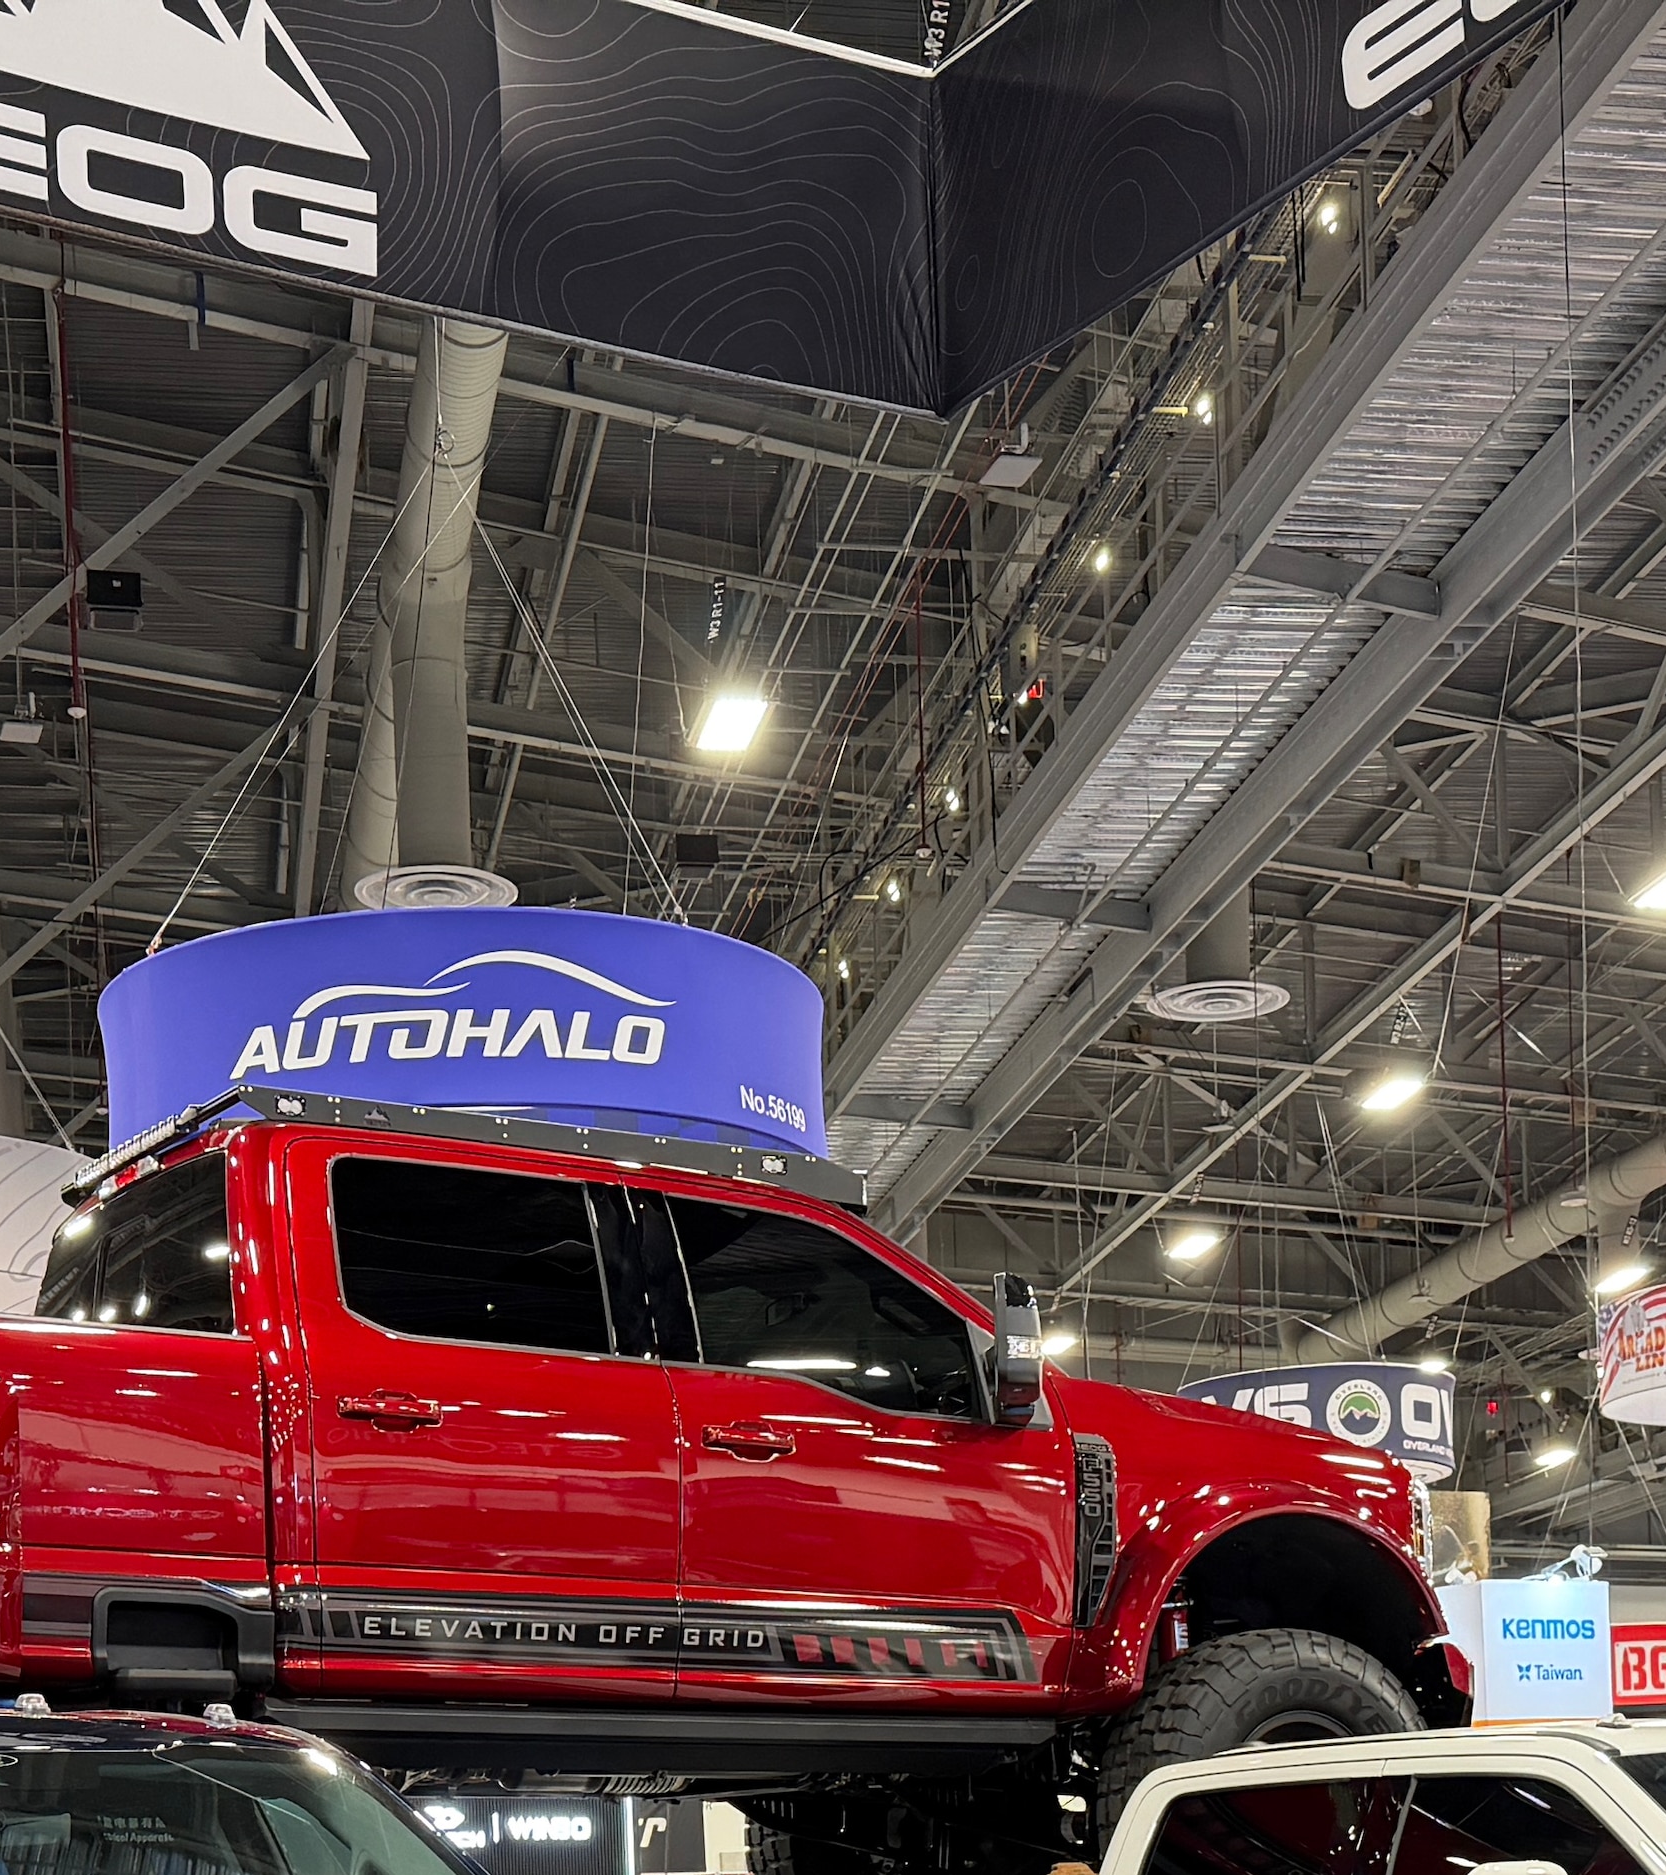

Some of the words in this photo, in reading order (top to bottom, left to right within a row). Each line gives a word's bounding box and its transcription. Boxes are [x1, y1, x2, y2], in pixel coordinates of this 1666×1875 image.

[711, 582, 724, 618] R1-11
[708, 620, 721, 640] W3
[230, 1008, 665, 1080] AUTOHALO
[740, 1083, 807, 1133] No.56199
[363, 1615, 576, 1642] ELEVATION
[599, 1624, 665, 1644] OFF
[683, 1627, 765, 1648] GRID
[1534, 1664, 1583, 1681] Taiwan
